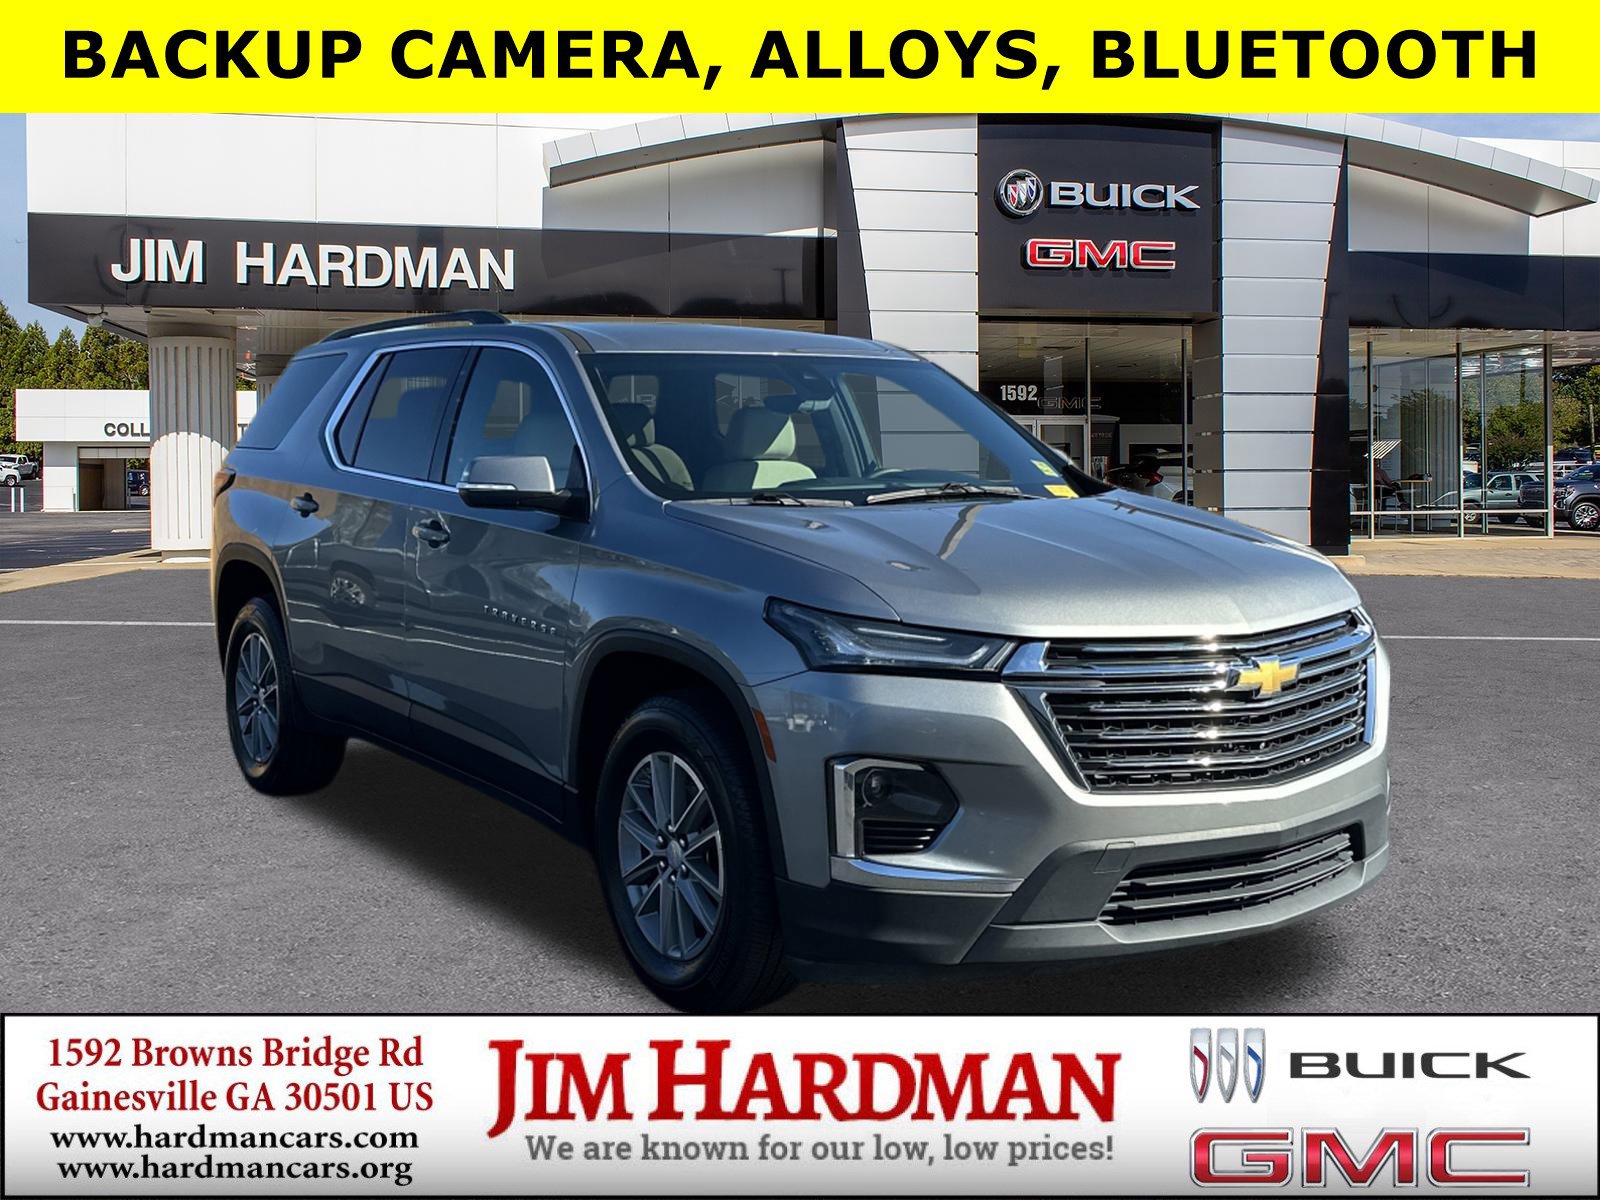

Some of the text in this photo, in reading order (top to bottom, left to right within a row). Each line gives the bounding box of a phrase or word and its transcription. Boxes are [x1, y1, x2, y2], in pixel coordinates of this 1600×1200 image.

[1050, 181, 1201, 209] BUICK
[111, 238, 515, 291] JIM HARDMAN
[1025, 238, 1176, 270] GMC
[1000, 384, 1037, 401] 1592
[1037, 396, 1102, 410] GMC
